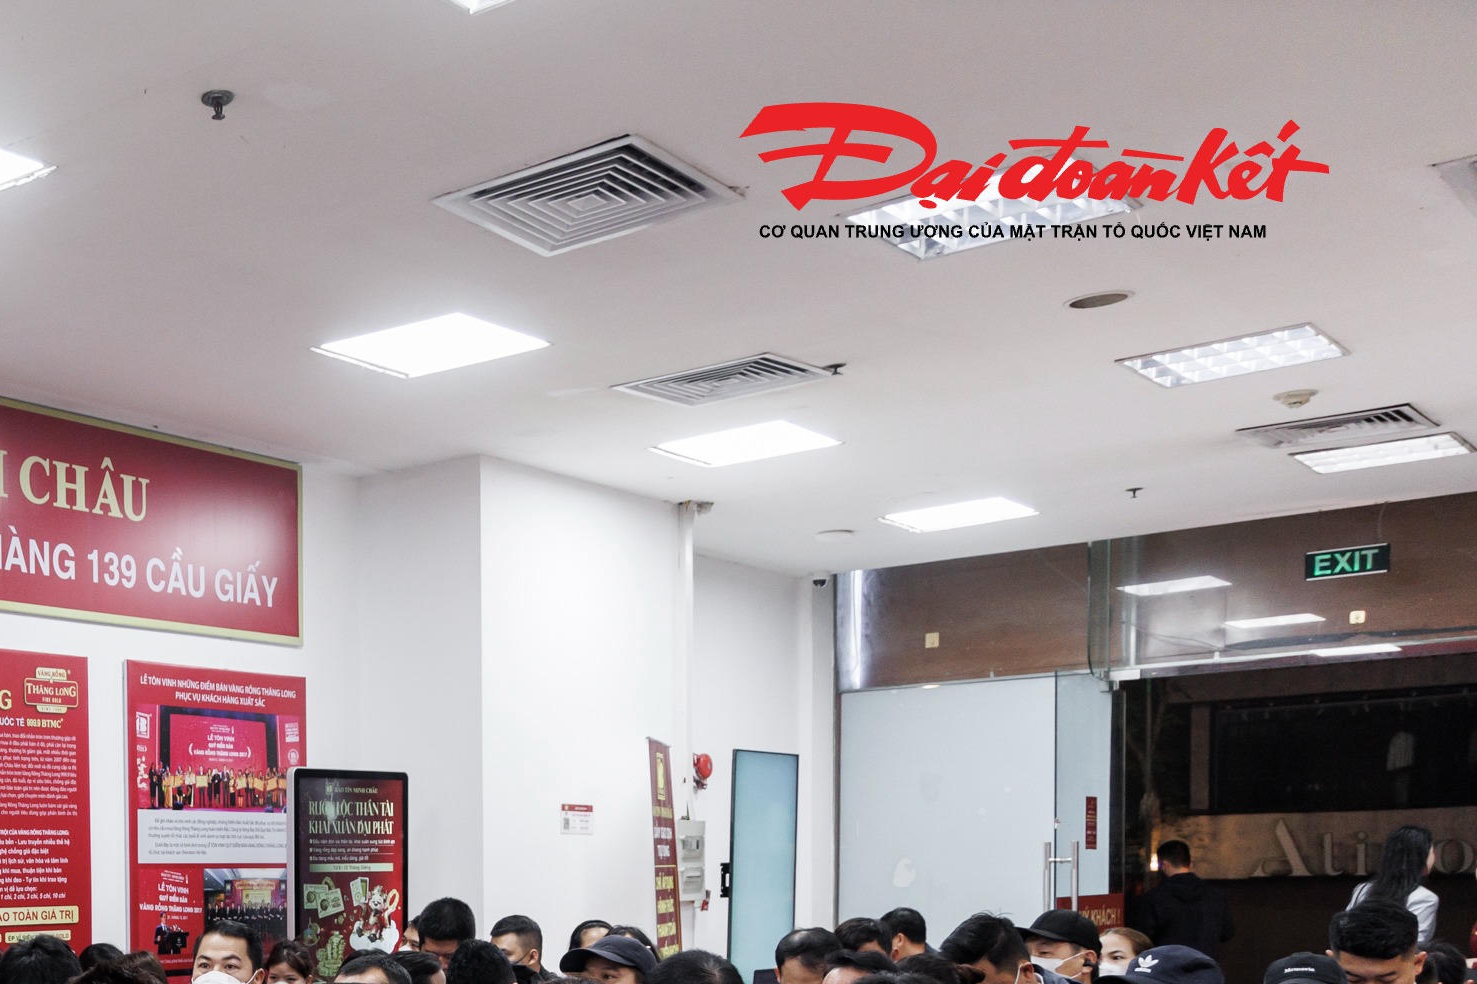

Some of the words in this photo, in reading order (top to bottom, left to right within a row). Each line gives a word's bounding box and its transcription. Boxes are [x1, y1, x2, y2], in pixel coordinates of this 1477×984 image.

[20, 456, 154, 526] CHÂU
[1314, 548, 1380, 577] EXIT
[88, 550, 136, 588] 139
[146, 545, 206, 598] CẦU
[214, 558, 278, 607] GIẤY
[148, 676, 161, 685] TÔN
[162, 678, 176, 687] VINH
[228, 684, 244, 694] VÀNG
[281, 690, 296, 698] LONG
[176, 691, 191, 702] PHỤC
[202, 694, 221, 703] KHÁCH
[222, 695, 239, 704] HÀNG
[12, 908, 39, 921] TOÀN
[41, 909, 57, 920] GIÁ
[59, 910, 74, 922] TRỊ
